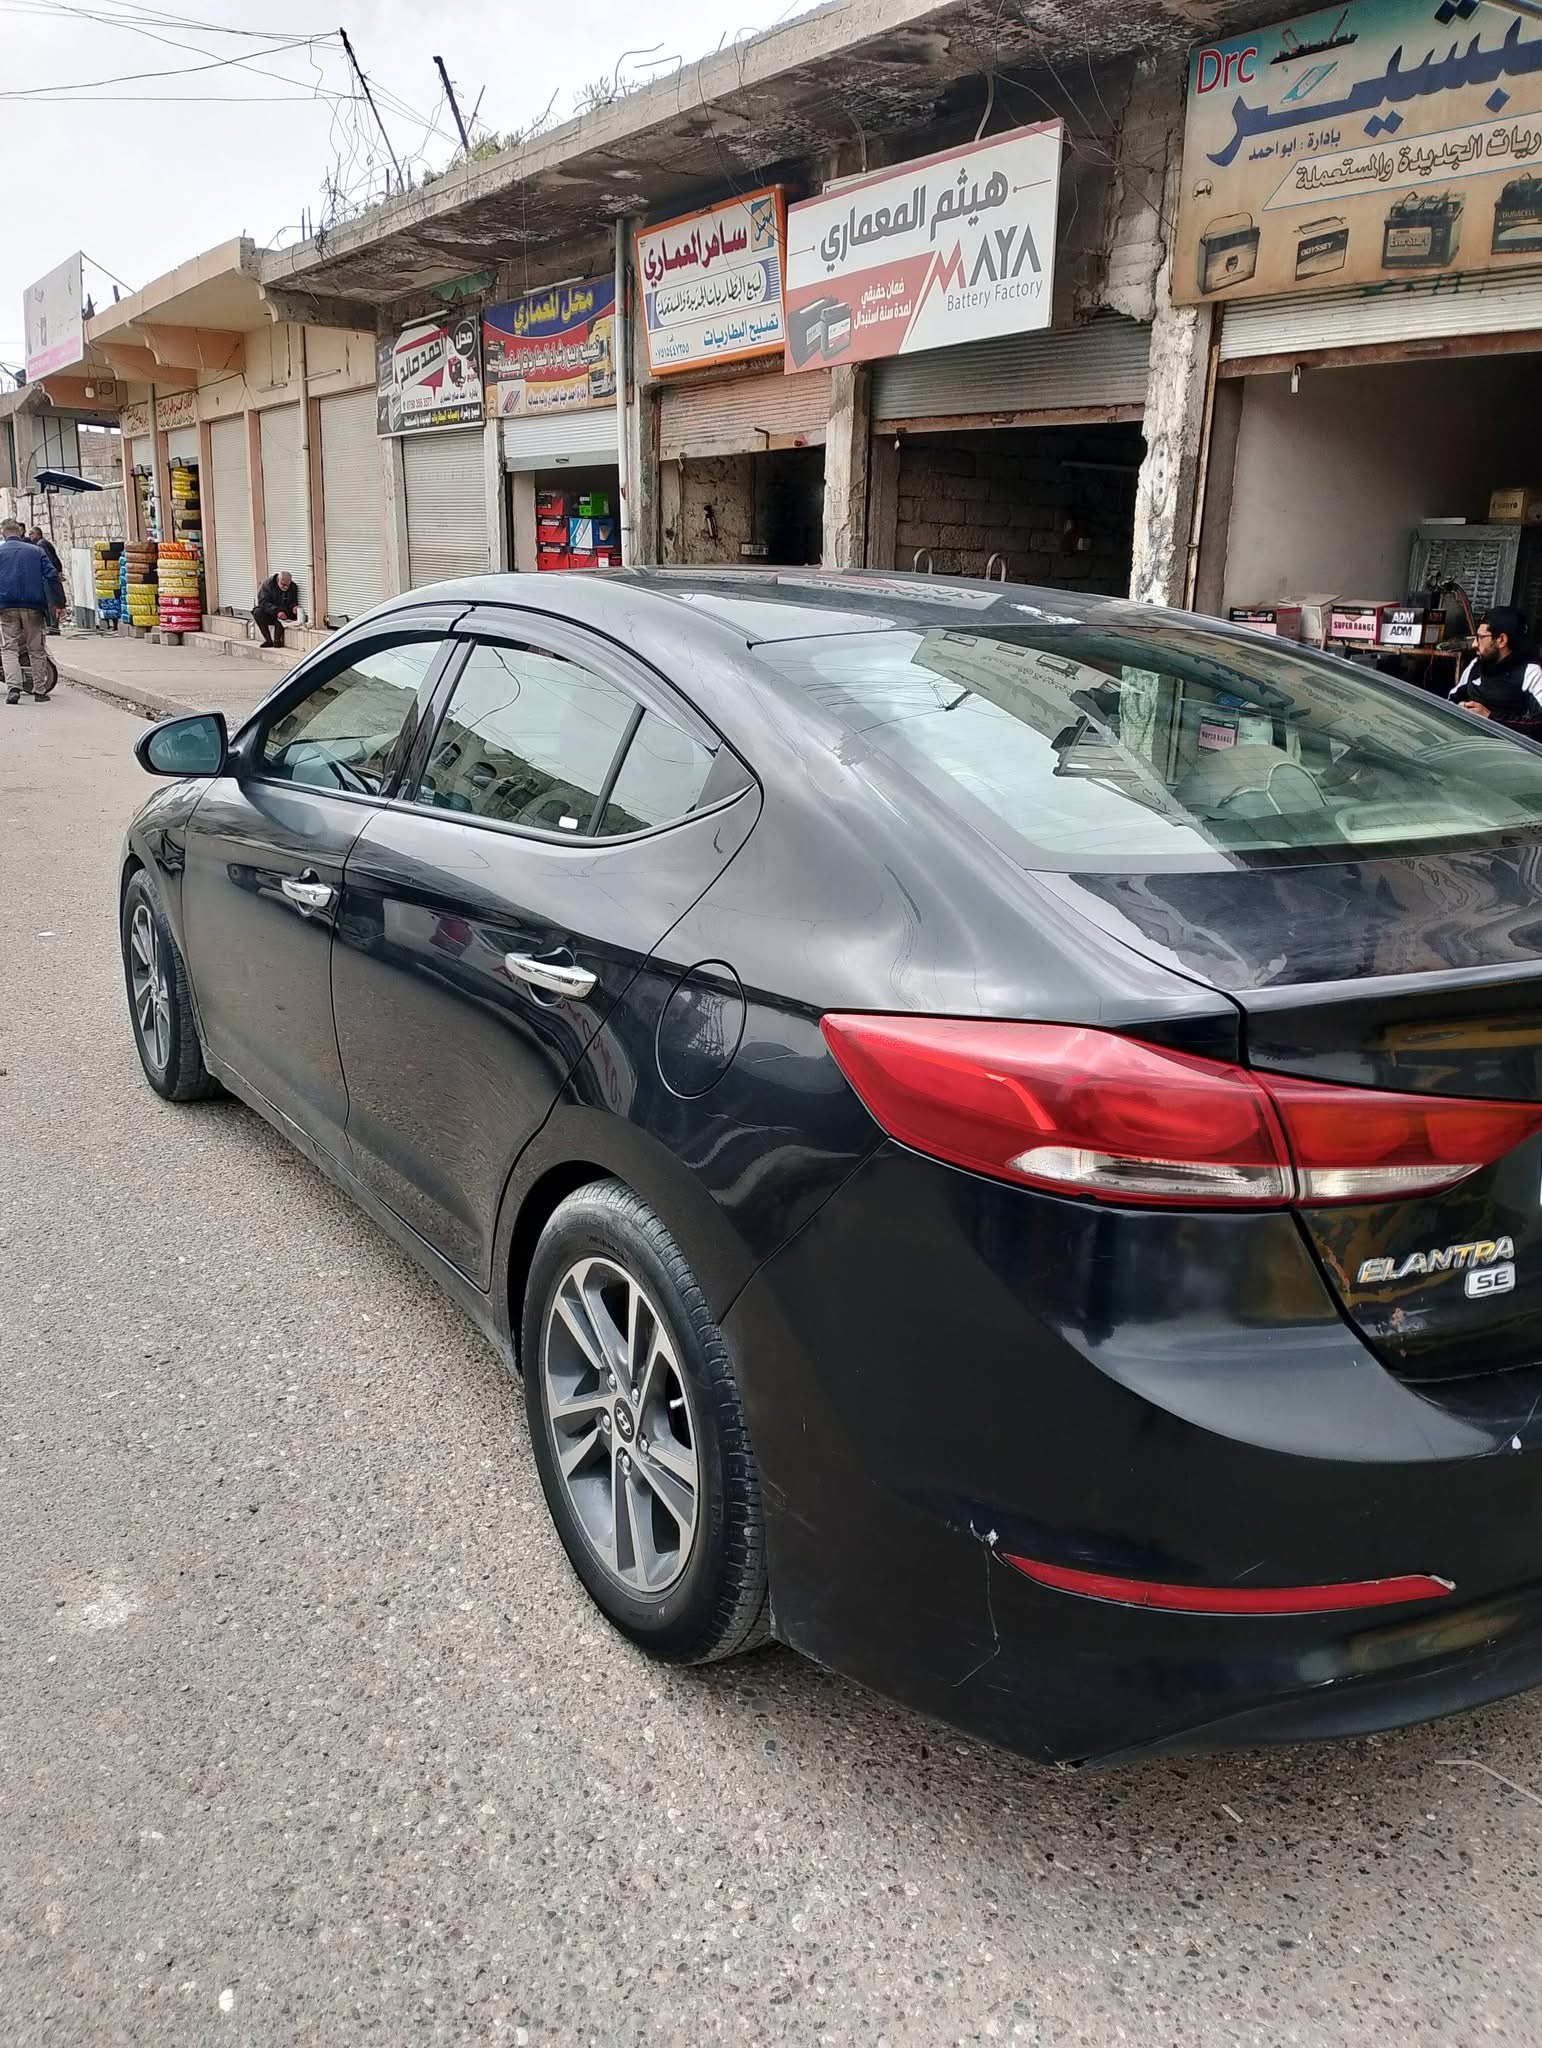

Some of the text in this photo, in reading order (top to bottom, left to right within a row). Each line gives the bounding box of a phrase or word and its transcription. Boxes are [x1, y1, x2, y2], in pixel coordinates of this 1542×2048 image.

[1196, 48, 1258, 95] Drc
[1248, 141, 1279, 161] احمد
[1398, 132, 1484, 177] الجديدة
[1295, 151, 1395, 190] والمستعملة
[819, 168, 1009, 273] هيثم المعماري
[644, 221, 748, 288] ساهر المعماري
[928, 223, 1042, 295] MAYA
[1300, 241, 1333, 257] ODYSSEY
[861, 277, 905, 309] ضمان حقيقي
[893, 299, 912, 318] لمدة
[946, 278, 1043, 313] Battery Factory
[513, 287, 593, 337] محل المعماري
[853, 306, 880, 330] استبدال
[879, 305, 894, 321] سنة
[455, 331, 474, 350] محل
[703, 313, 779, 348] تصليح البطاريات
[421, 332, 446, 369] احمد
[400, 355, 421, 391] صالح
[1333, 620, 1375, 632] SUPER RANGE
[1389, 625, 1413, 637] ADM
[1391, 611, 1416, 623] ADM
[1356, 1235, 1515, 1284] ELANTRA
[1476, 1270, 1509, 1290] SE
